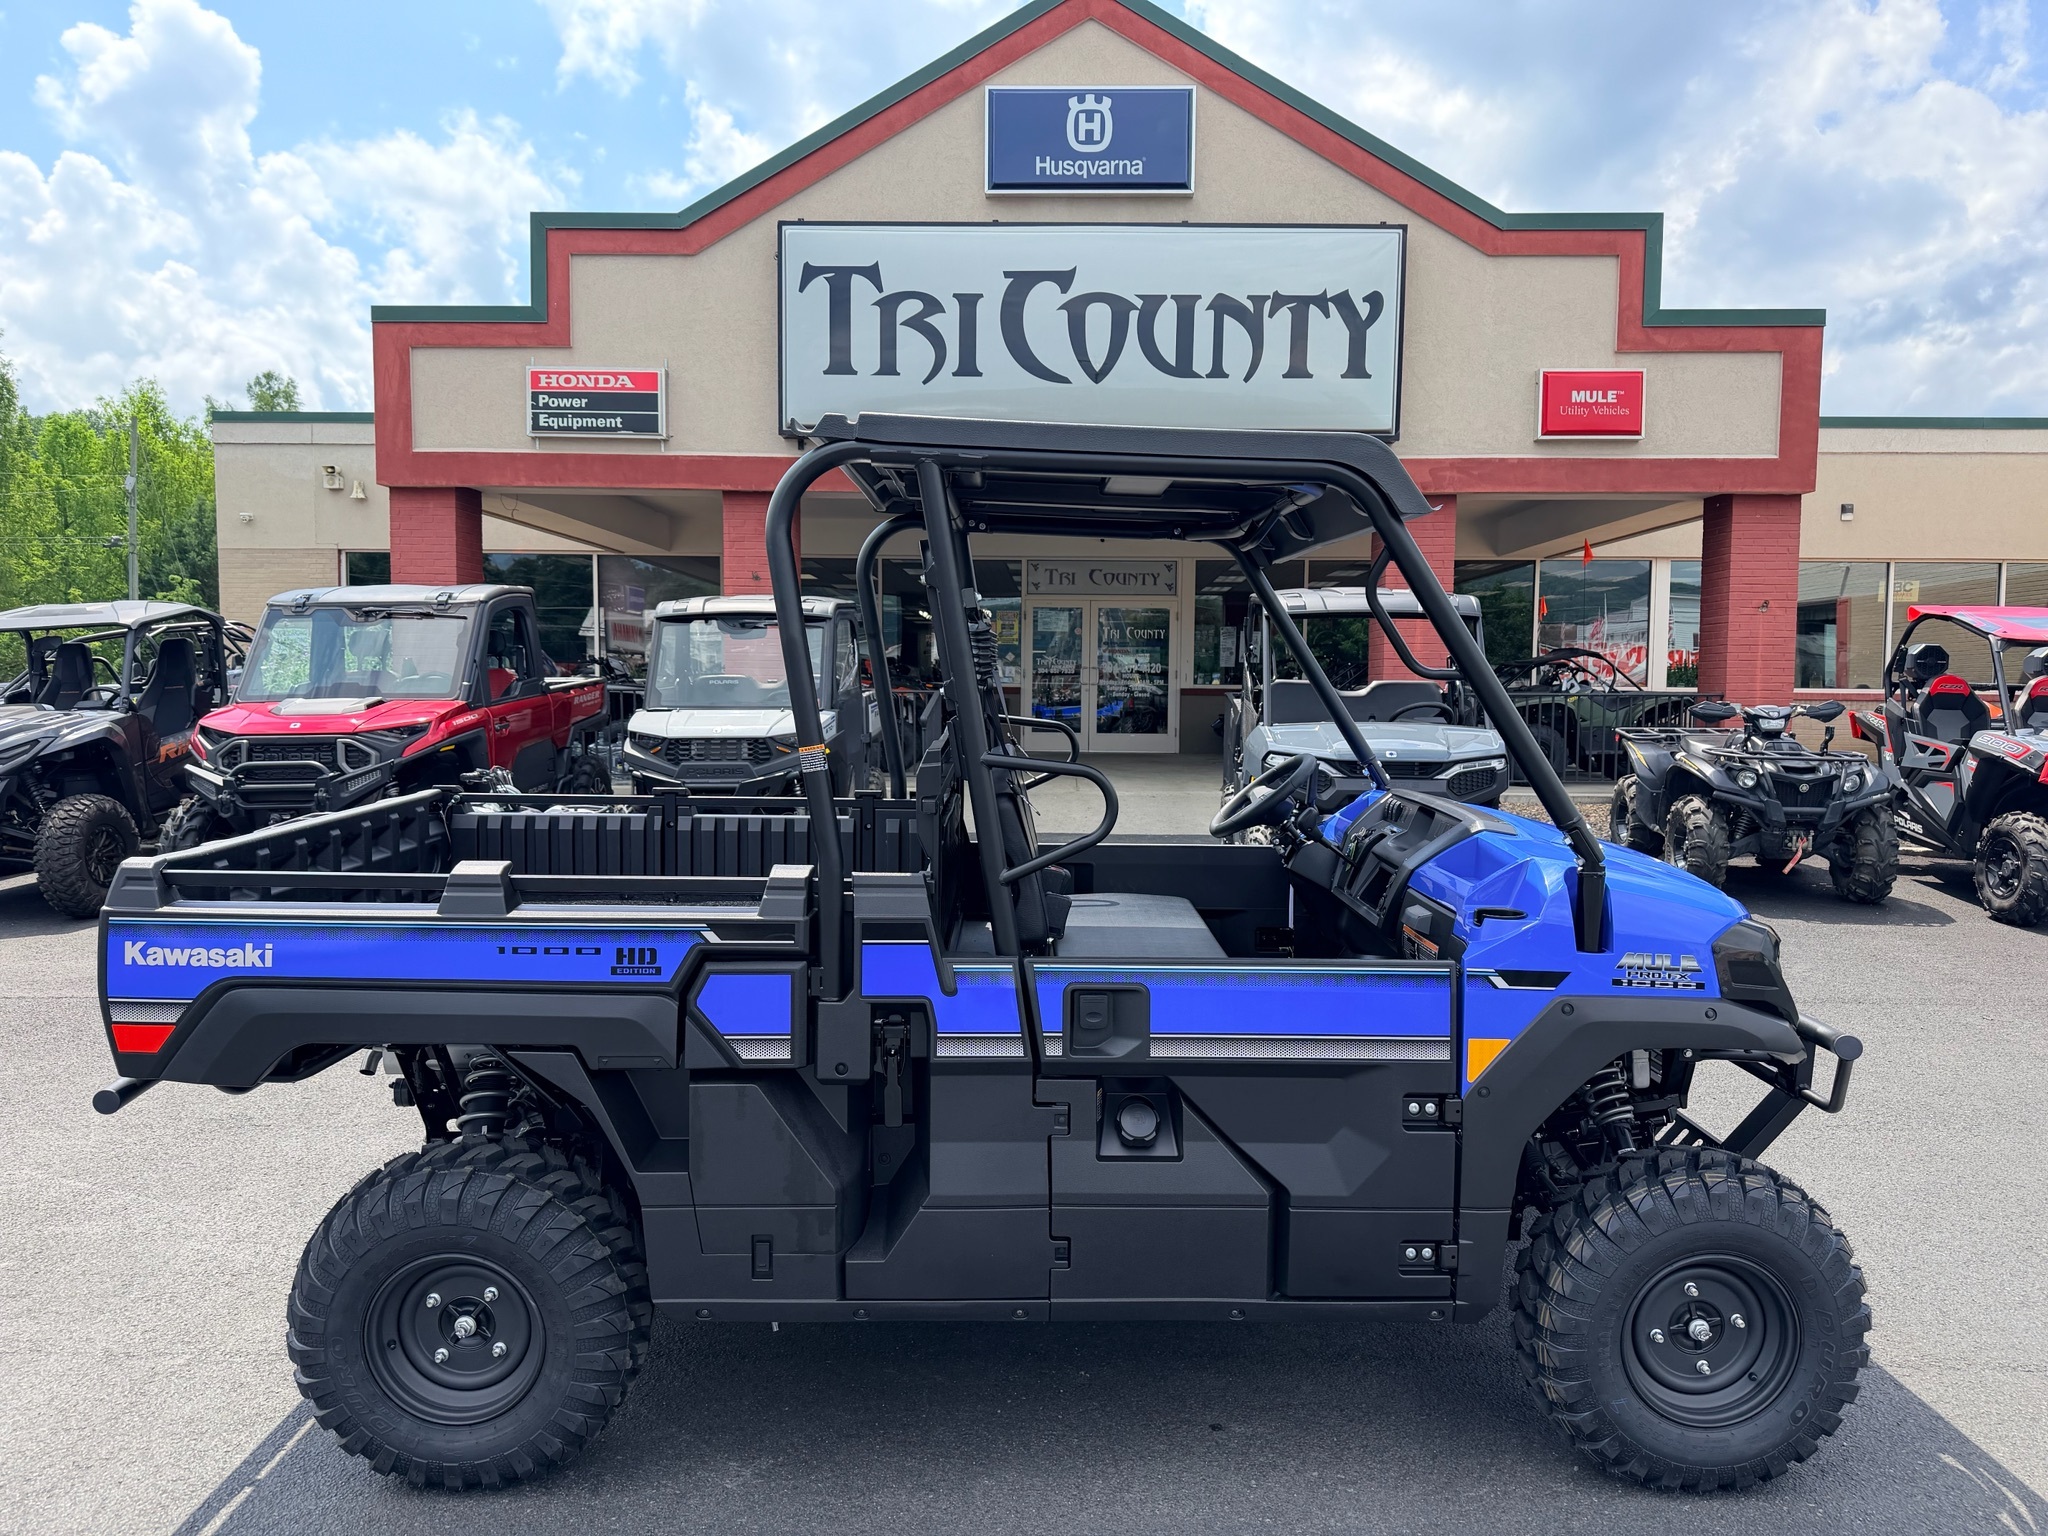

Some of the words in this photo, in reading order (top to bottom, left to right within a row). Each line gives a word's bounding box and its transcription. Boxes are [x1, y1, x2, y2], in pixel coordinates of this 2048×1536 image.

[1035, 155, 1145, 179] Husqvarna
[538, 374, 635, 388] HONDA
[538, 394, 588, 408] Power
[1560, 405, 1590, 418] Utility
[1592, 405, 1630, 416] Vehicles
[538, 413, 623, 430] Equipment
[573, 690, 600, 705] RANGER
[452, 714, 479, 726] 1500
[1976, 735, 2022, 753] 900
[251, 751, 334, 763] POLARIS
[686, 767, 745, 776] POLARIS
[1893, 815, 1923, 834] POLARIS
[124, 941, 273, 968] Kawasaki
[496, 946, 602, 956] 1000
[615, 947, 658, 966] HD
[1615, 952, 1704, 973] MULE
[616, 967, 656, 975] EDITION
[1620, 979, 1697, 990] 1000
